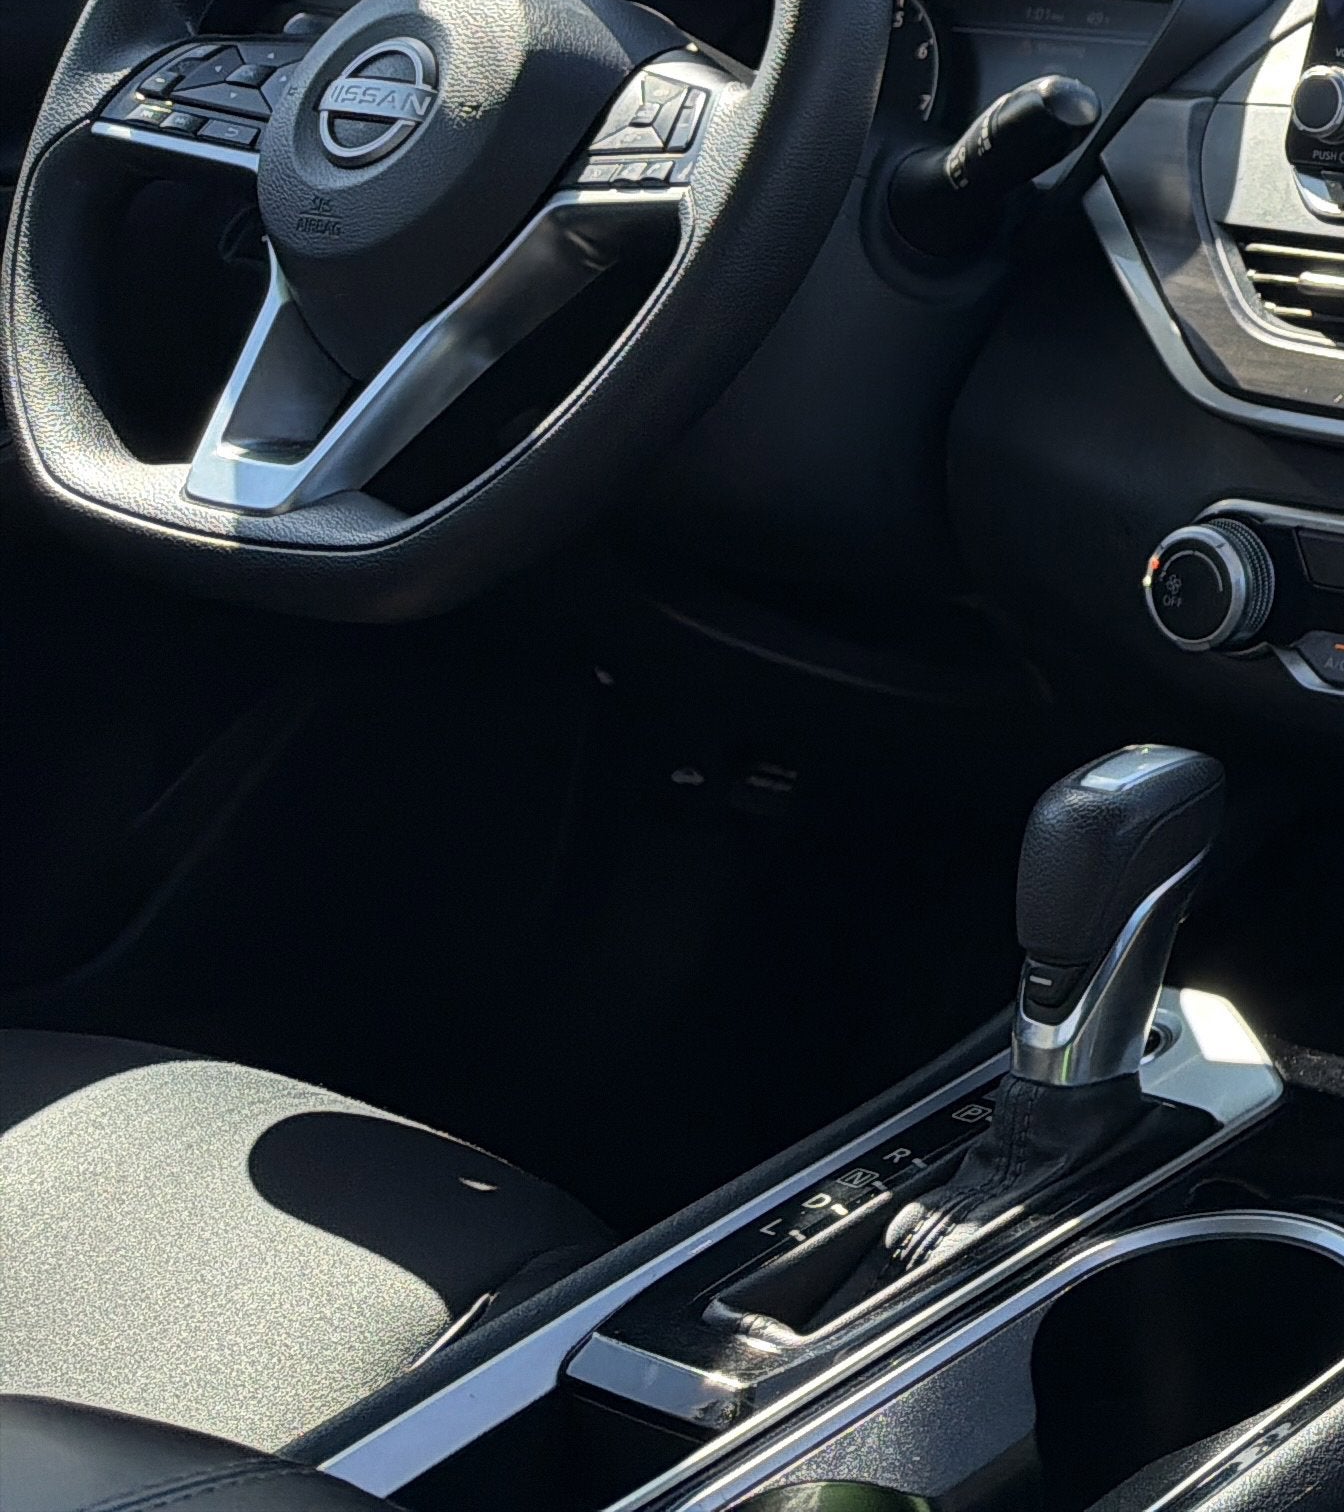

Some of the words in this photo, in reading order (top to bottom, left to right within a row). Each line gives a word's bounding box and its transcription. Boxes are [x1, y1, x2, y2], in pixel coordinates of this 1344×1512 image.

[893, 10, 905, 27] 5
[917, 42, 928, 60] 6
[920, 93, 932, 110] 7
[1312, 149, 1337, 161] PUSH
[1163, 594, 1182, 607] OFF
[962, 1106, 982, 1119] P
[883, 1147, 911, 1164] R
[850, 1171, 869, 1186] N
[801, 1192, 832, 1209] D
[759, 1218, 783, 1236] L
